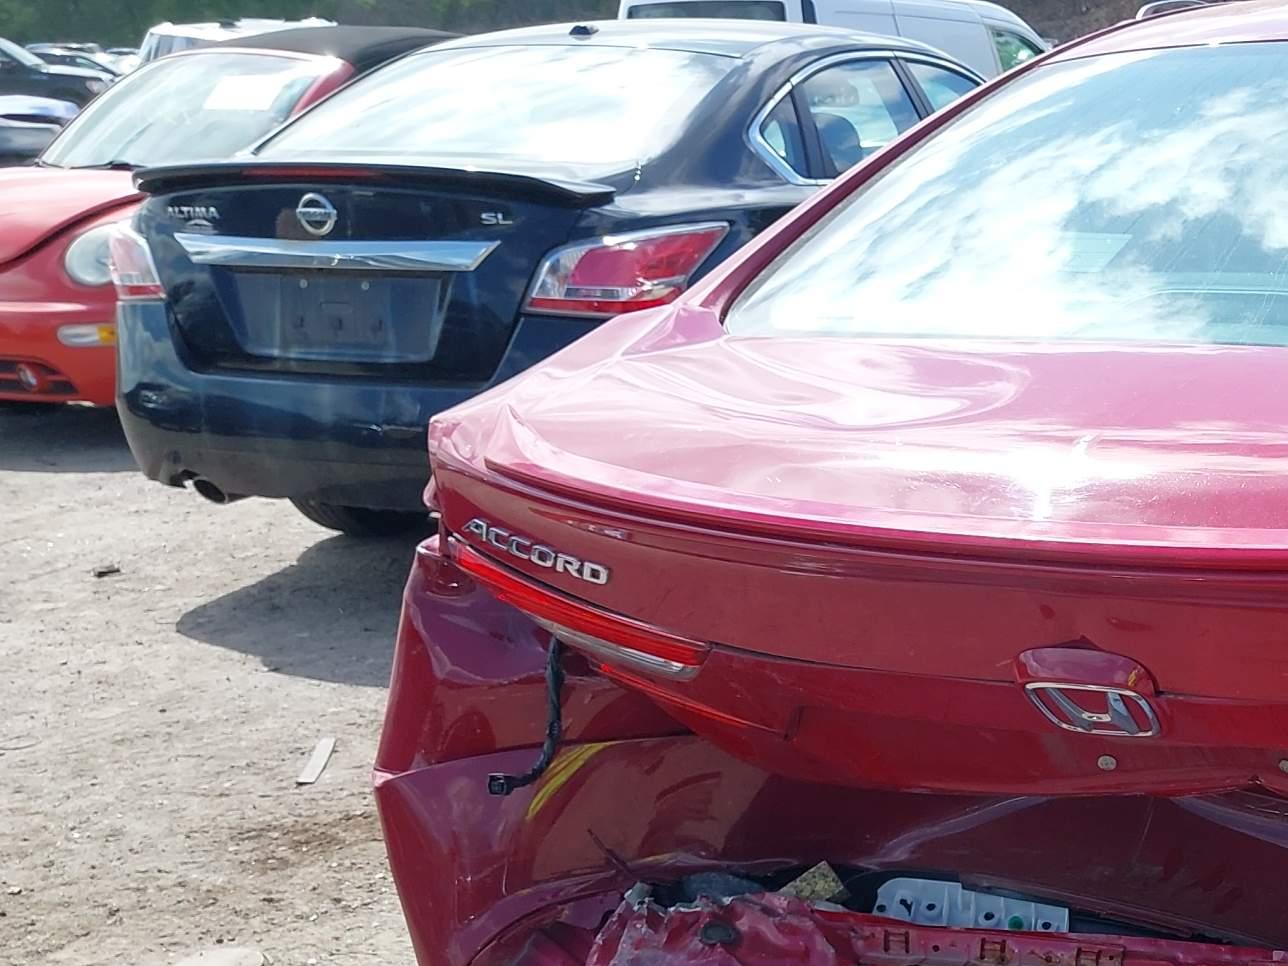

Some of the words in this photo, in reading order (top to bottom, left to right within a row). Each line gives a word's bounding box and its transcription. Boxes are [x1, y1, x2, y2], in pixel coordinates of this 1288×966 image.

[166, 206, 220, 219] ALTIMA
[481, 212, 513, 225] SL
[461, 518, 609, 586] ACCORD
